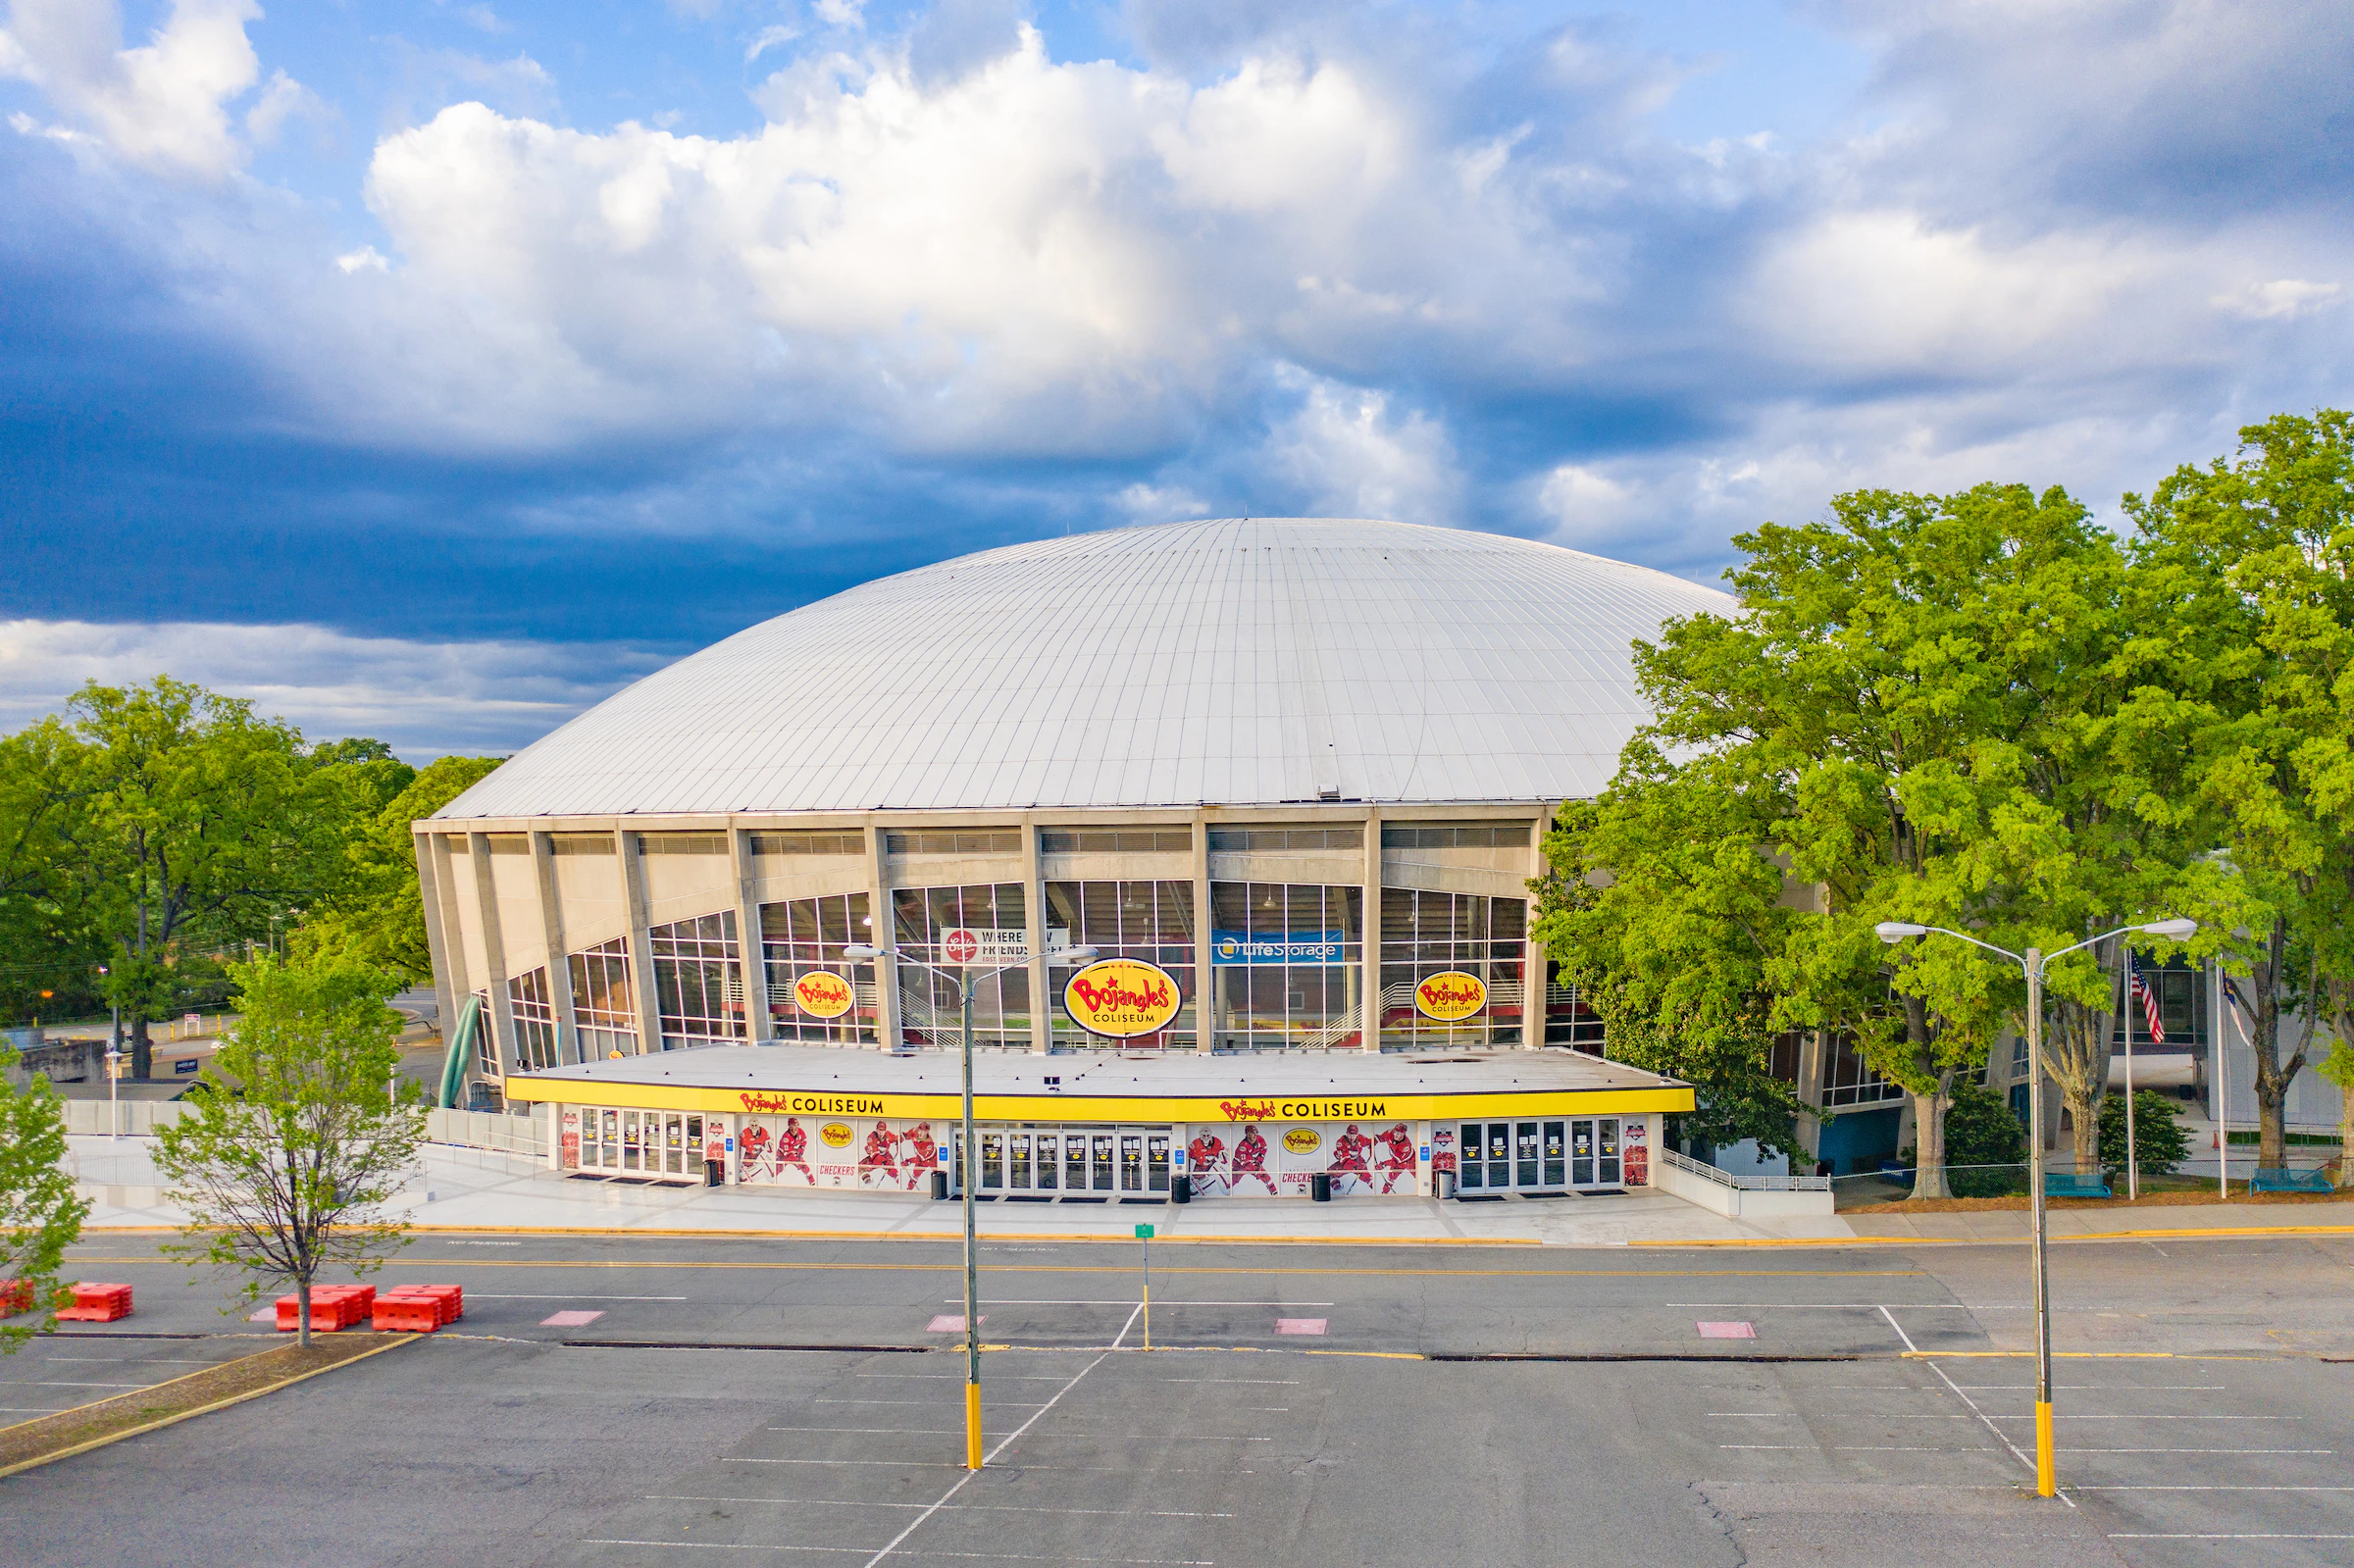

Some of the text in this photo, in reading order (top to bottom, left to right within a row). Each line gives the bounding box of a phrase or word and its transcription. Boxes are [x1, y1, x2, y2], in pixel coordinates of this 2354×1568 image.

[982, 932, 1022, 942] WHERE
[1094, 1014, 1154, 1023] COLISEUM
[793, 1097, 884, 1114] COLISEUM
[1281, 1102, 1386, 1117] COLISEUM
[820, 1165, 855, 1176] CHECKERS
[1282, 1173, 1312, 1184] CHECKE
